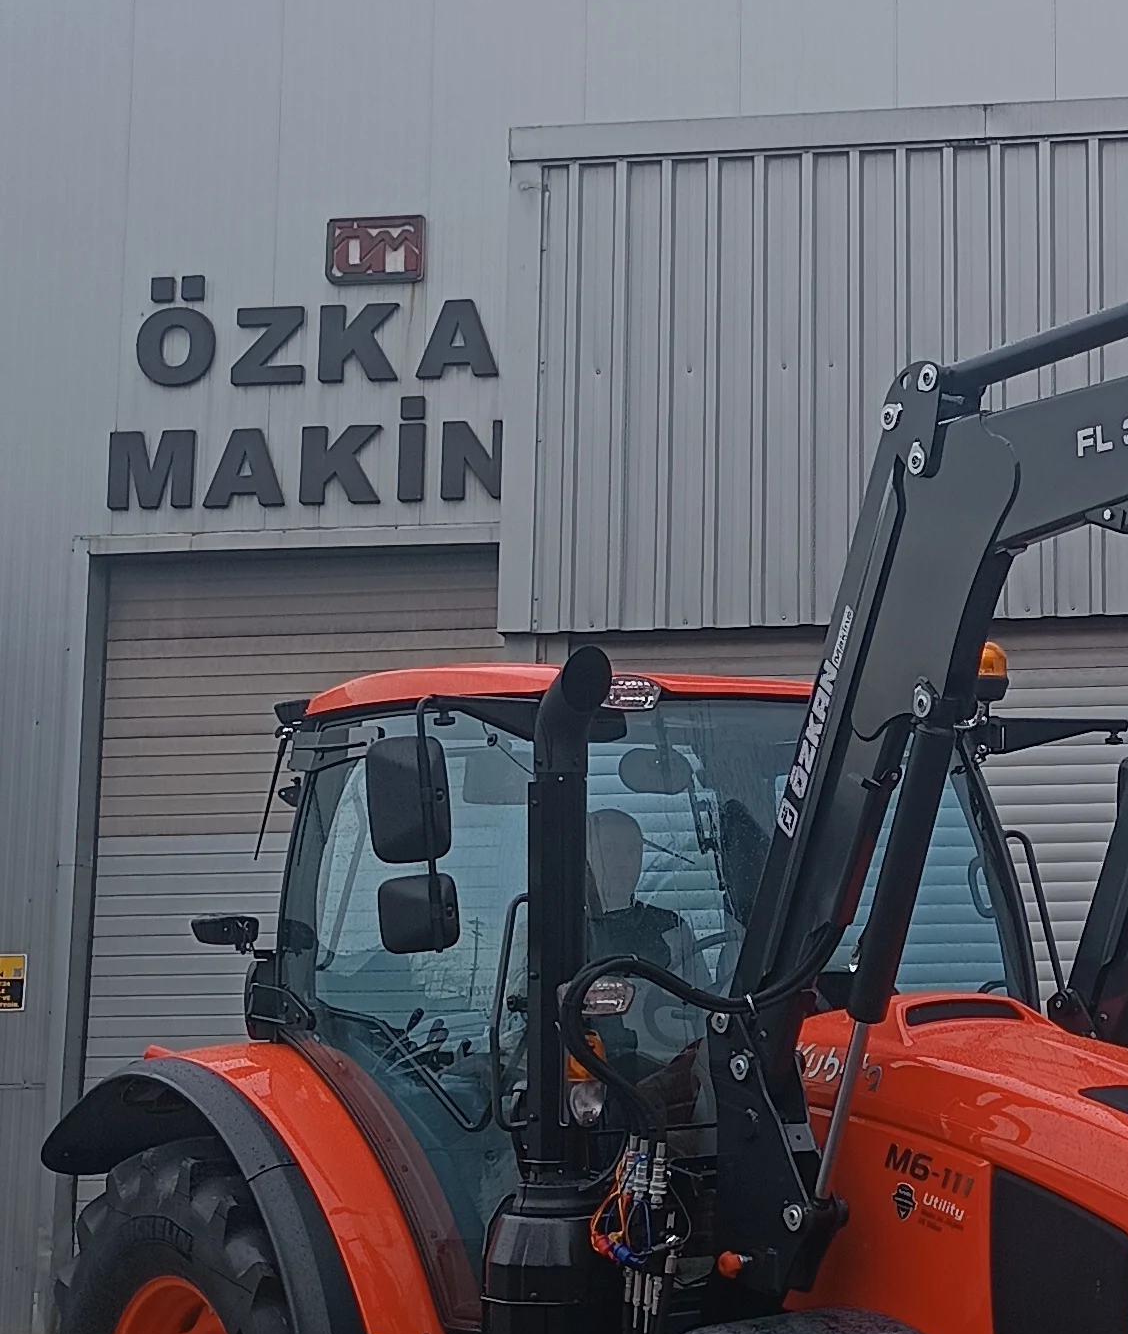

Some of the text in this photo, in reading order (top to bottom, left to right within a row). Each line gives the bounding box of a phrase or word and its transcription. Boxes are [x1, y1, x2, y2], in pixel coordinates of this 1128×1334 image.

[136, 275, 500, 387] ÖZKA
[107, 396, 503, 511] MAKİN
[1076, 425, 1114, 457] FL
[789, 658, 839, 799] ÖZKAN
[884, 1143, 974, 1198] M6-111
[922, 1192, 965, 1221] Utility
